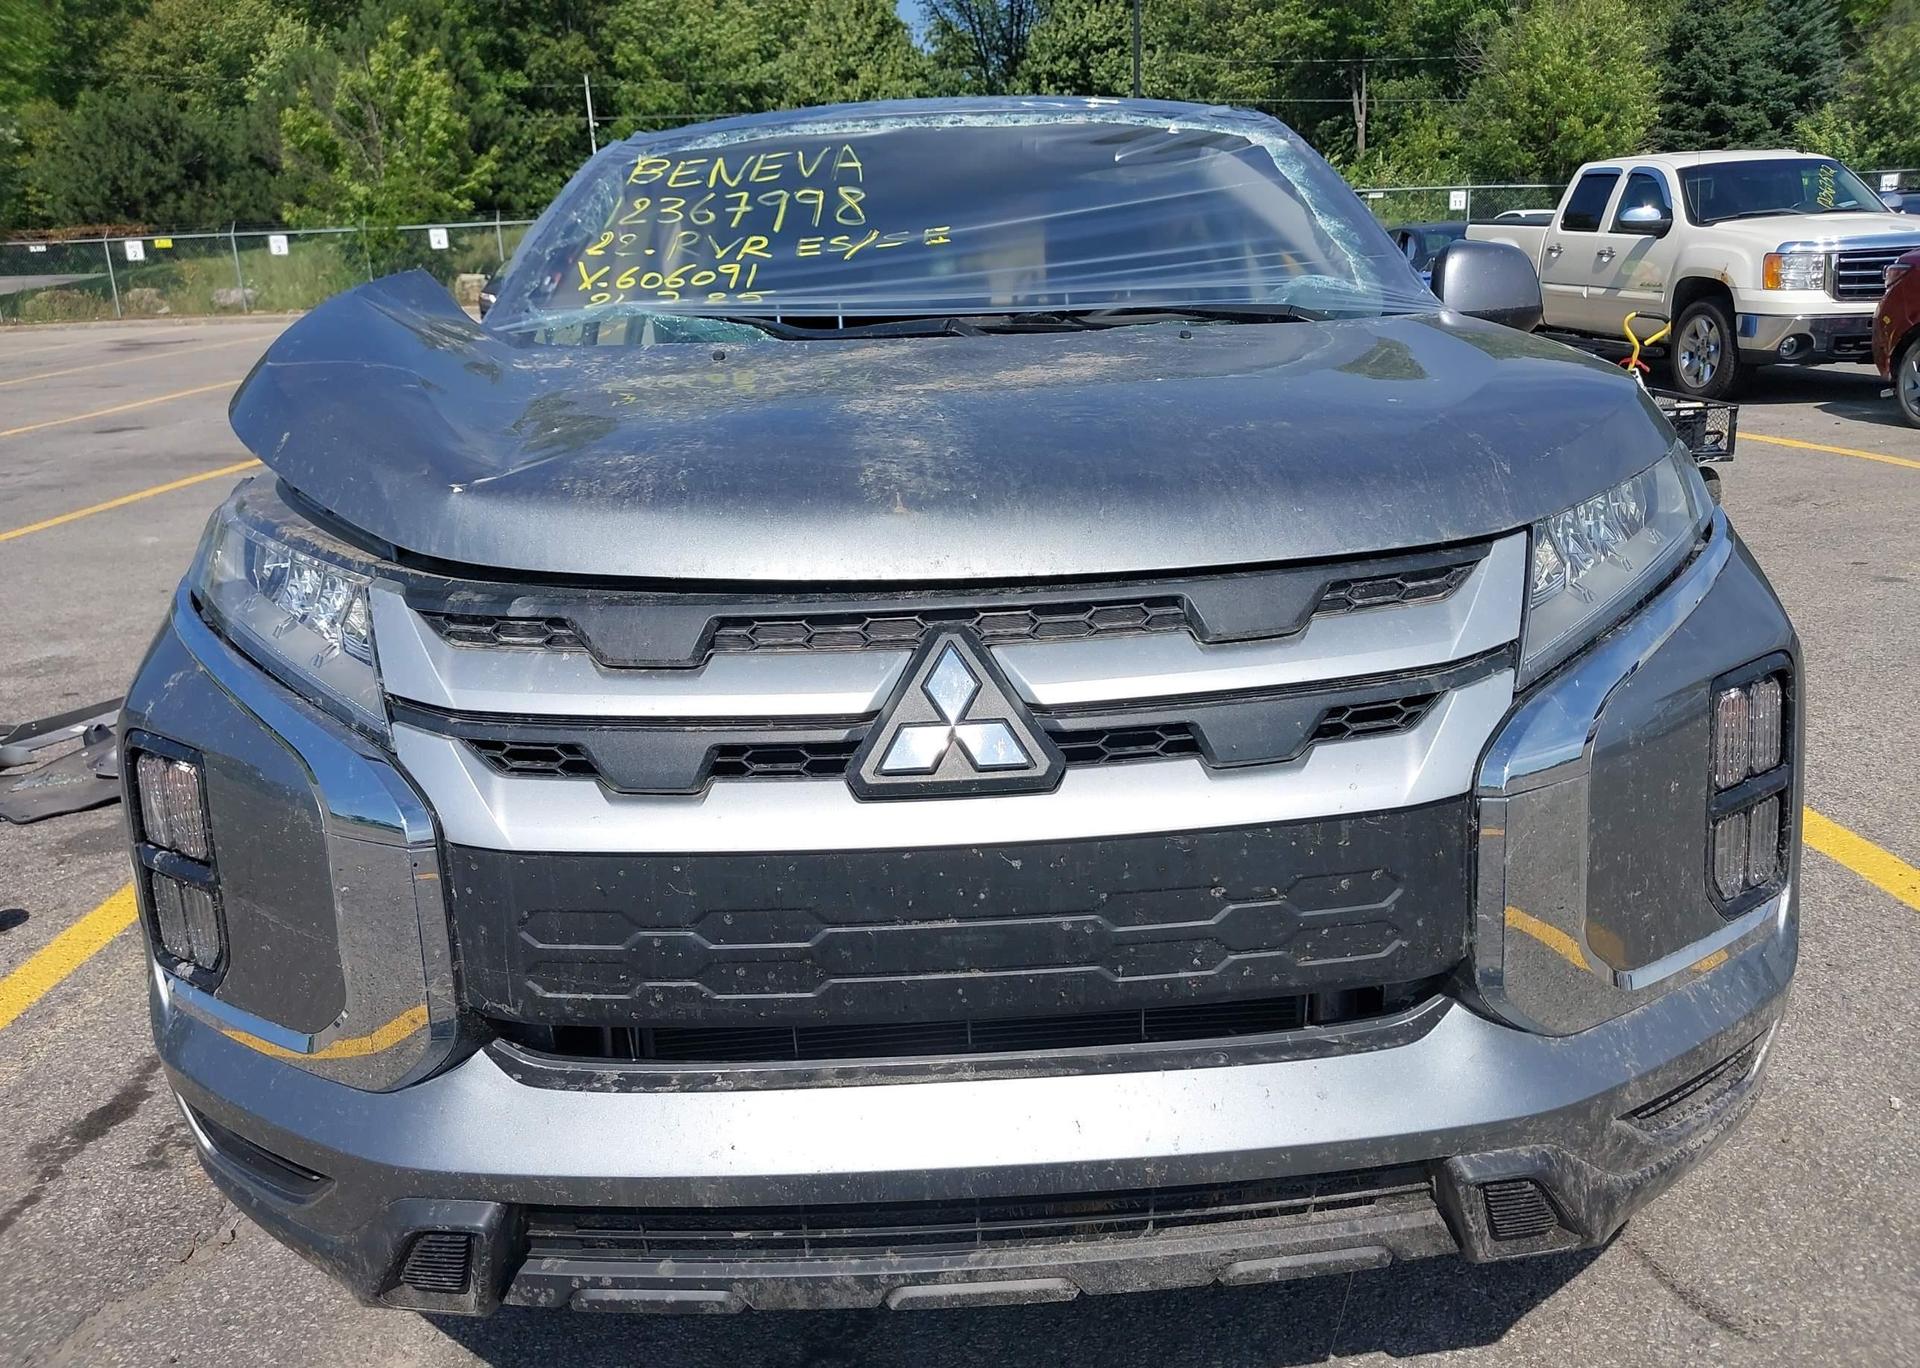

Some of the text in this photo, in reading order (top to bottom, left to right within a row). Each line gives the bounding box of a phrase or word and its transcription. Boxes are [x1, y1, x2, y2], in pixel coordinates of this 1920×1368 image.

[626, 144, 863, 189] BENEVA
[604, 186, 866, 233] 12367998
[666, 231, 773, 261] RVR
